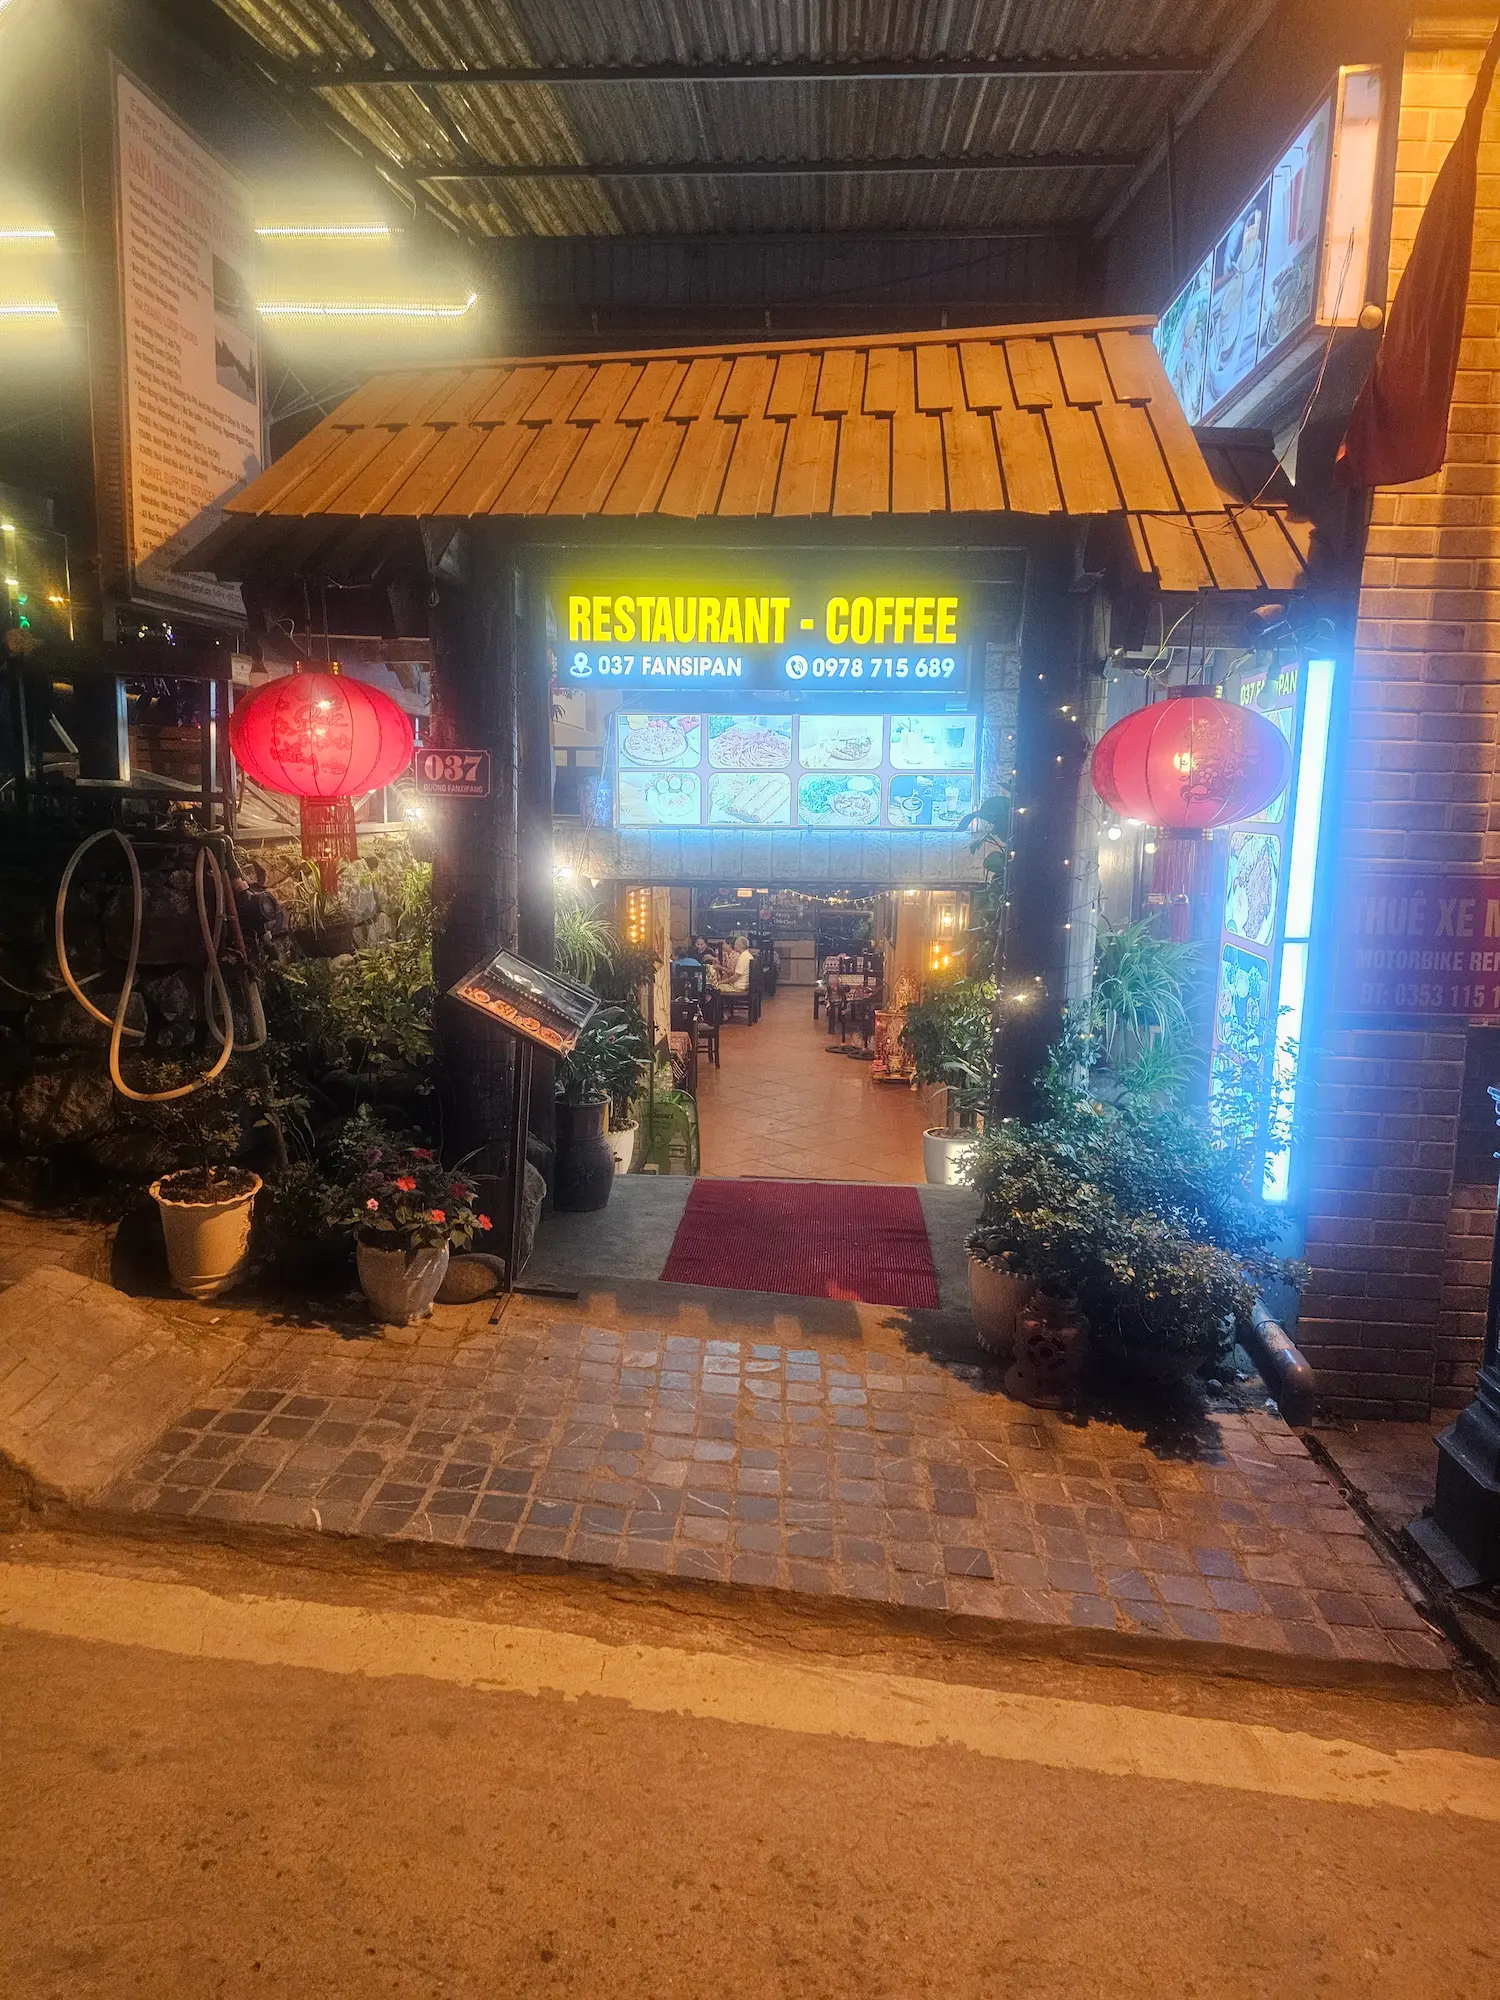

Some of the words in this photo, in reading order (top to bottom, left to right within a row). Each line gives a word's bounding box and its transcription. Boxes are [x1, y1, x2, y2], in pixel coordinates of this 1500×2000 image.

[569, 595, 791, 644] RESTAURANT
[826, 596, 958, 645] COFFEE
[598, 655, 635, 675] 037
[641, 655, 743, 677] FANSIPAN
[811, 656, 864, 678] 0978
[870, 657, 910, 678] 715
[914, 656, 956, 678] 689
[424, 754, 483, 782] 037
[1434, 898, 1477, 937] XE
[1355, 948, 1465, 972] MOTORBIKE
[1394, 982, 1443, 1007] 0353
[1450, 984, 1485, 1009] 115
